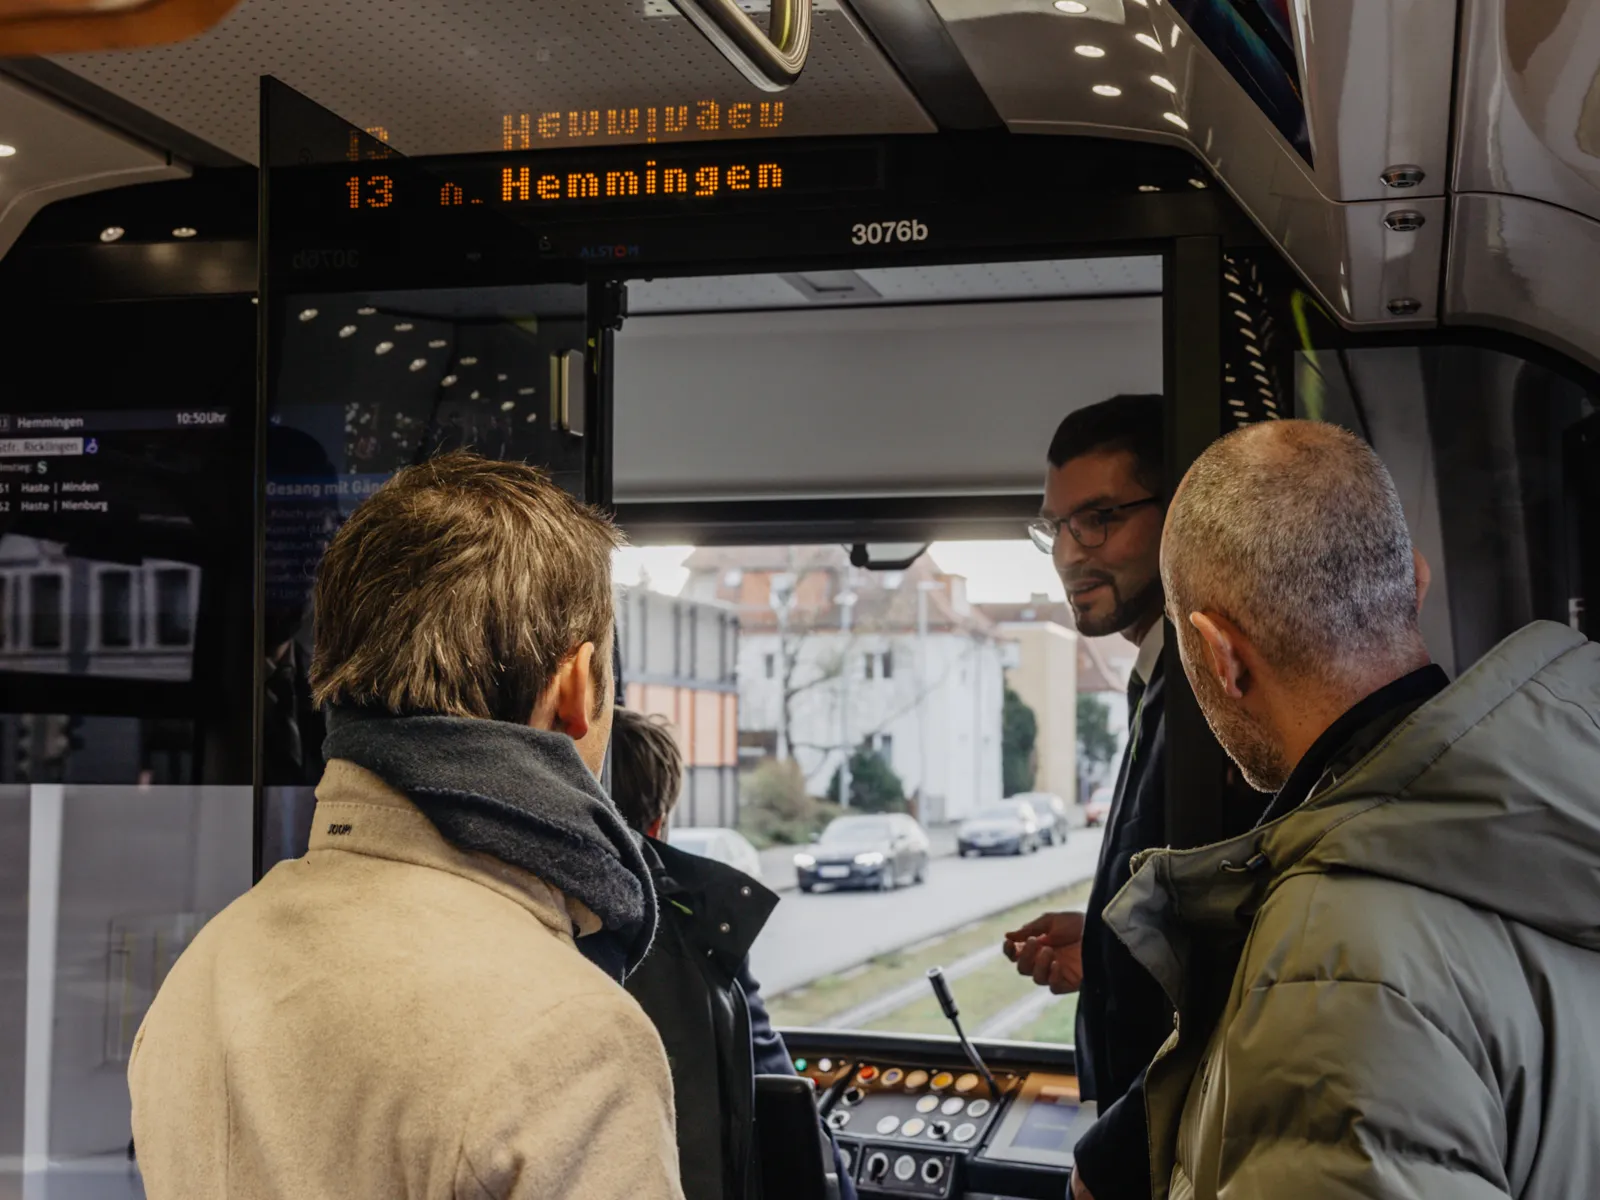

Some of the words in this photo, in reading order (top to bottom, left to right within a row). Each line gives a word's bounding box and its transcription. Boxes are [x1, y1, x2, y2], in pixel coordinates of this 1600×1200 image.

[345, 174, 394, 209] 13
[501, 160, 783, 202] Hemmingen
[851, 218, 929, 246] 3076b
[580, 243, 640, 258] ALSTOM
[17, 416, 84, 431] Hemmingen
[24, 440, 79, 454] Ricklingen
[21, 482, 51, 494] Haste
[61, 481, 100, 493] Minden
[266, 482, 322, 498] Gesang
[324, 481, 350, 496] mit
[21, 501, 51, 512] Haste
[61, 500, 109, 513] Nienburg
